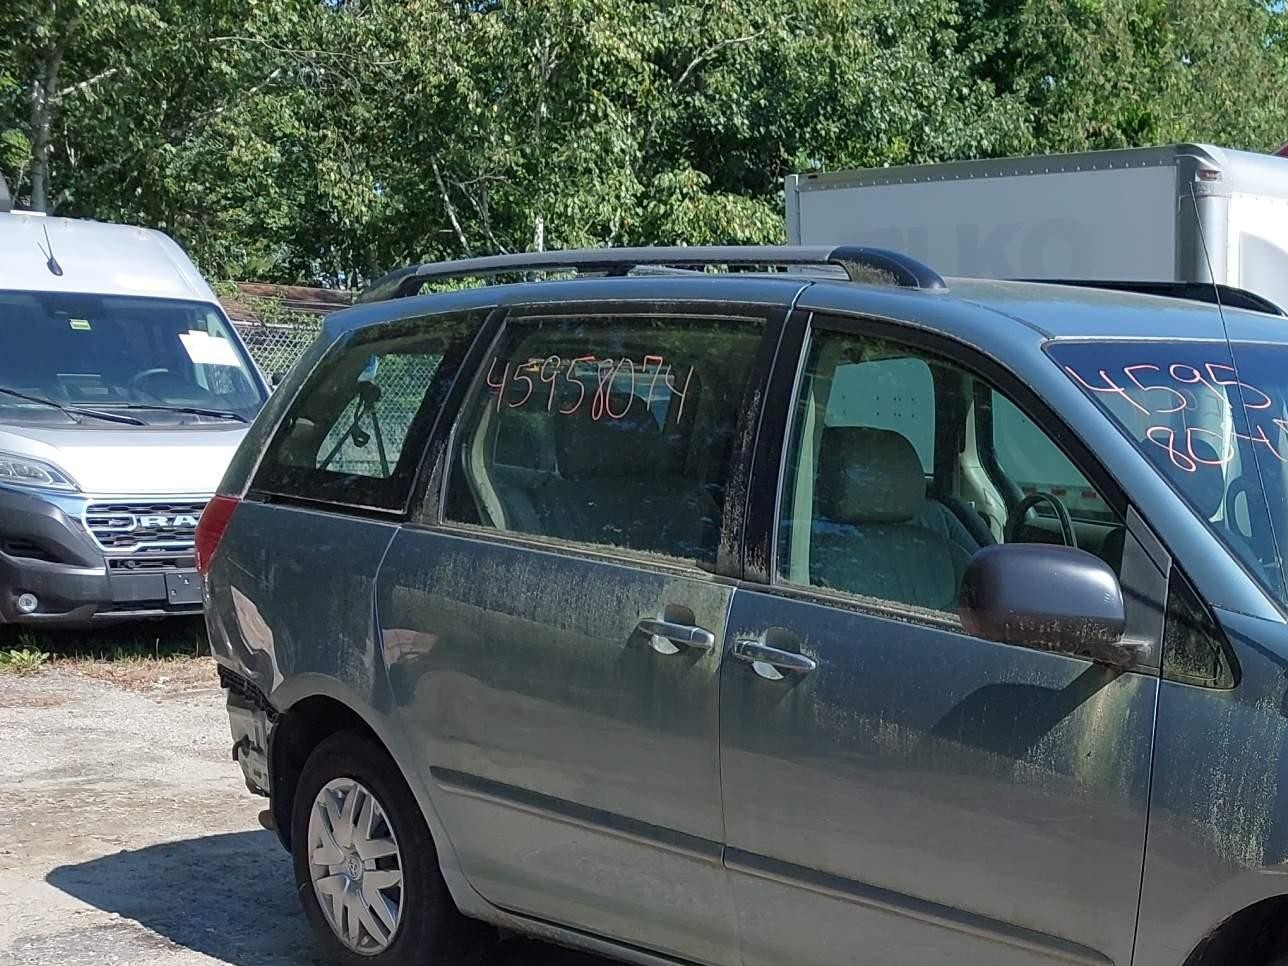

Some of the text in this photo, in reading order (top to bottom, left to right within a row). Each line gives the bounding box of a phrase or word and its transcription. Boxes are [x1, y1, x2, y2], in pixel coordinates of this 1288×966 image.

[486, 355, 694, 424] 45958074
[1065, 362, 1272, 416] 4595
[140, 515, 198, 528] RA
